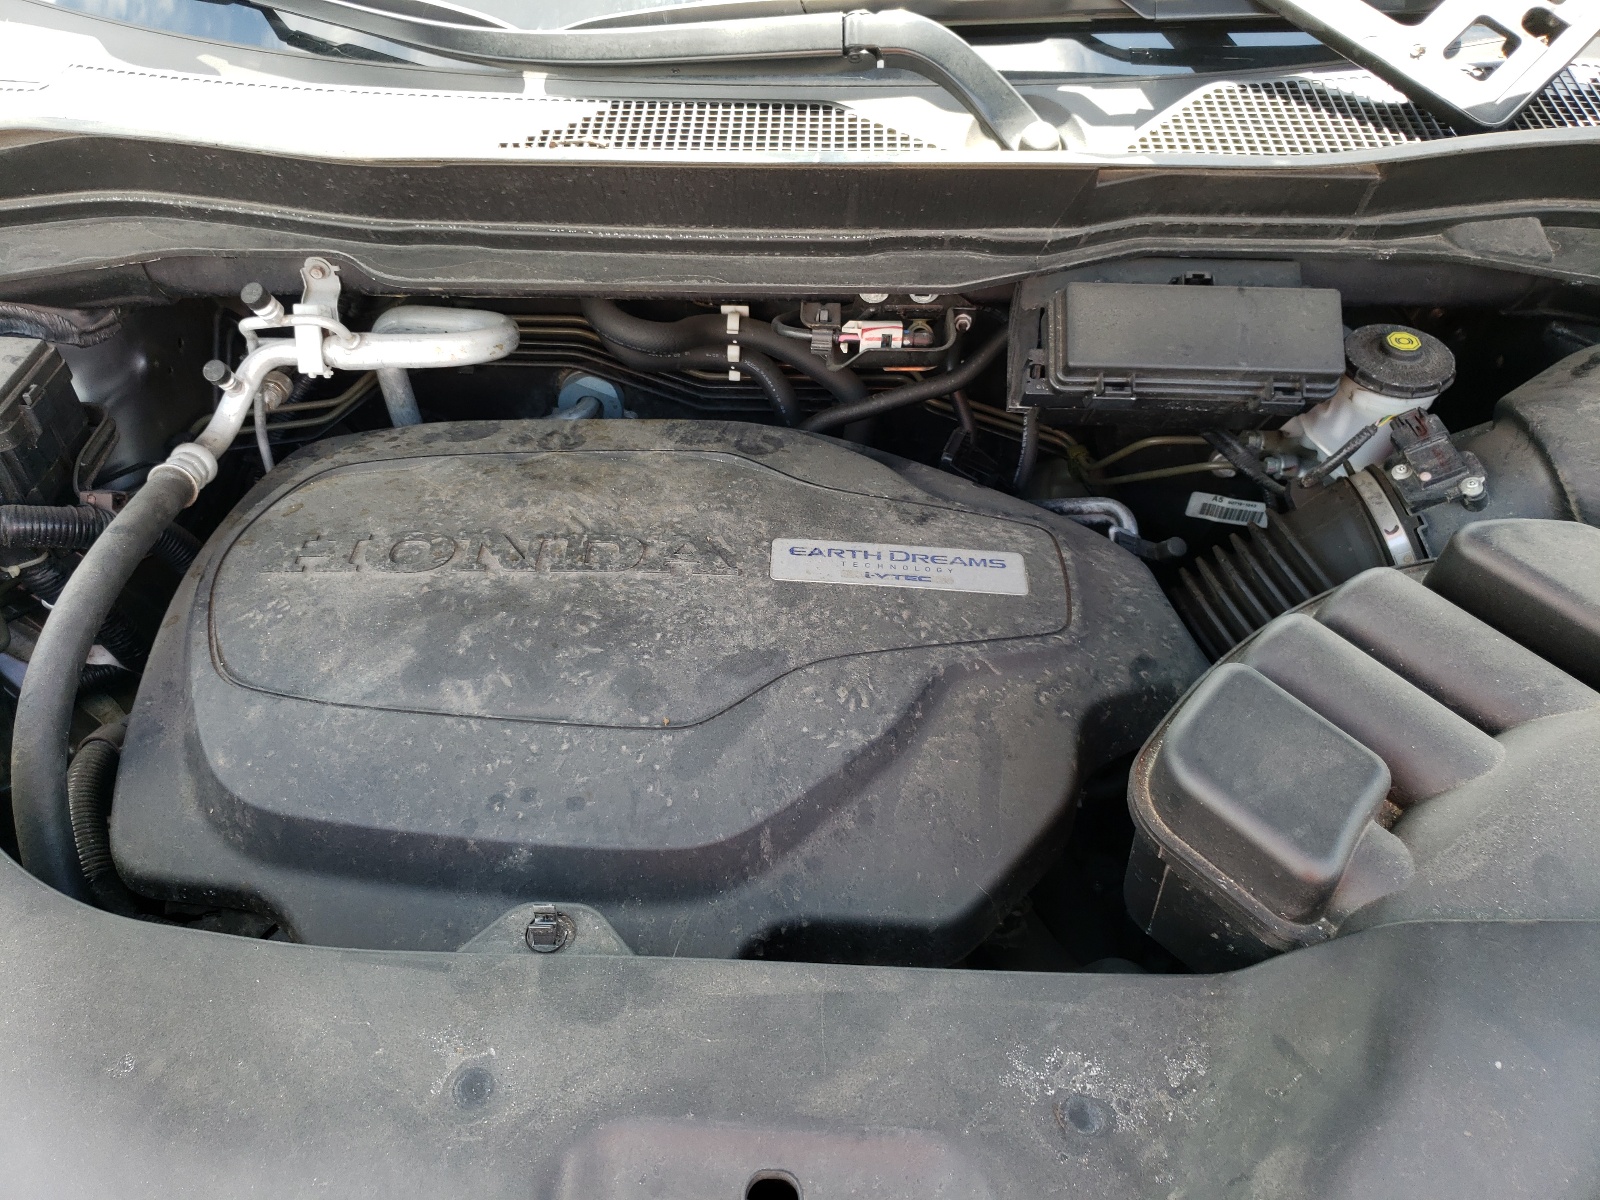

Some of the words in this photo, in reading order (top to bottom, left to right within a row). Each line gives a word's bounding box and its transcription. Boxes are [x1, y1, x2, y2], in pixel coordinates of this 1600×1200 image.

[262, 532, 742, 576] HONDA
[788, 546, 882, 561] EARTH
[889, 550, 1007, 569] DREAMS
[841, 561, 954, 574] TECHNOLOGY
